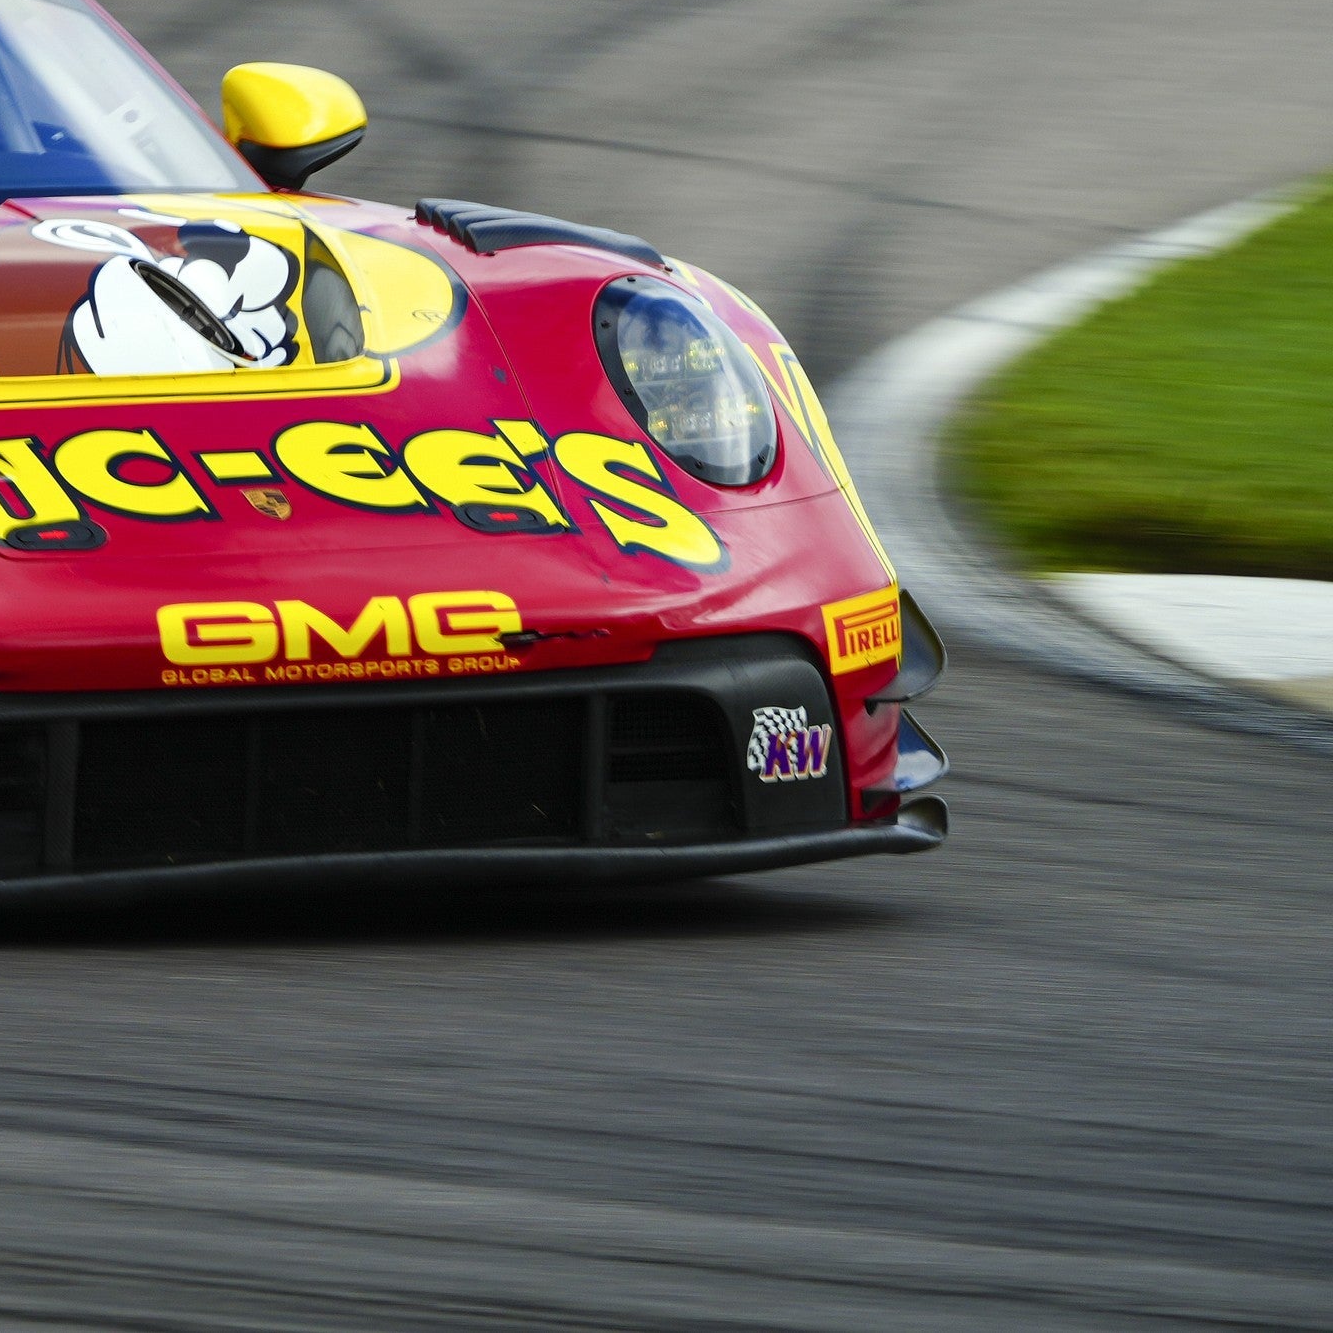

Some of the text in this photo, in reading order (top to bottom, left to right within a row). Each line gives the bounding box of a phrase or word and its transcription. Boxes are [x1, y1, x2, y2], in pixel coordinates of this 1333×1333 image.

[156, 590, 523, 666] GMG
[161, 655, 522, 685] GLOBAL MOTORSPORTS GROUP
[758, 723, 833, 784] KW
